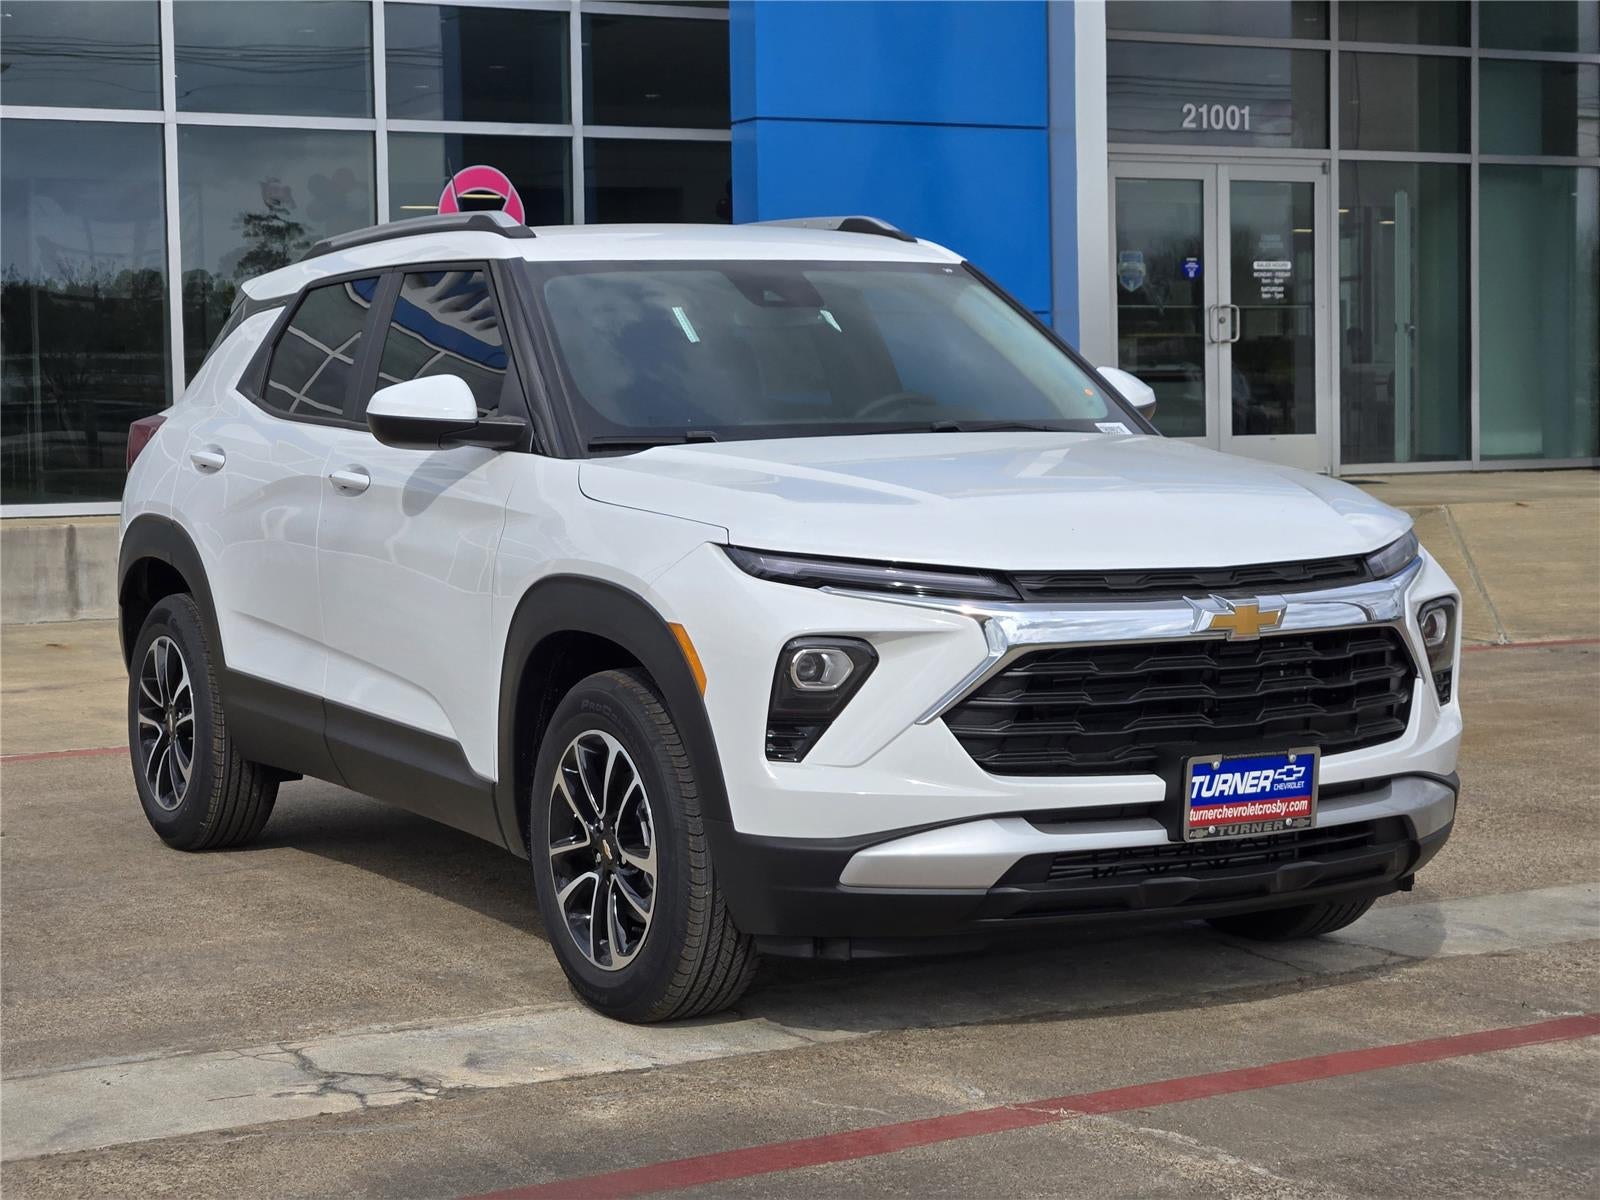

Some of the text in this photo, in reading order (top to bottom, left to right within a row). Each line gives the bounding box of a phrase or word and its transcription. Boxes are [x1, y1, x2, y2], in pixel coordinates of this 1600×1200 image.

[1182, 103, 1250, 130] 21001
[1191, 769, 1274, 799] TURNER
[1273, 781, 1305, 791] CHEVROLET
[1189, 800, 1308, 822] turnerchevroletcrosby.com
[1220, 822, 1284, 836] TURNER
